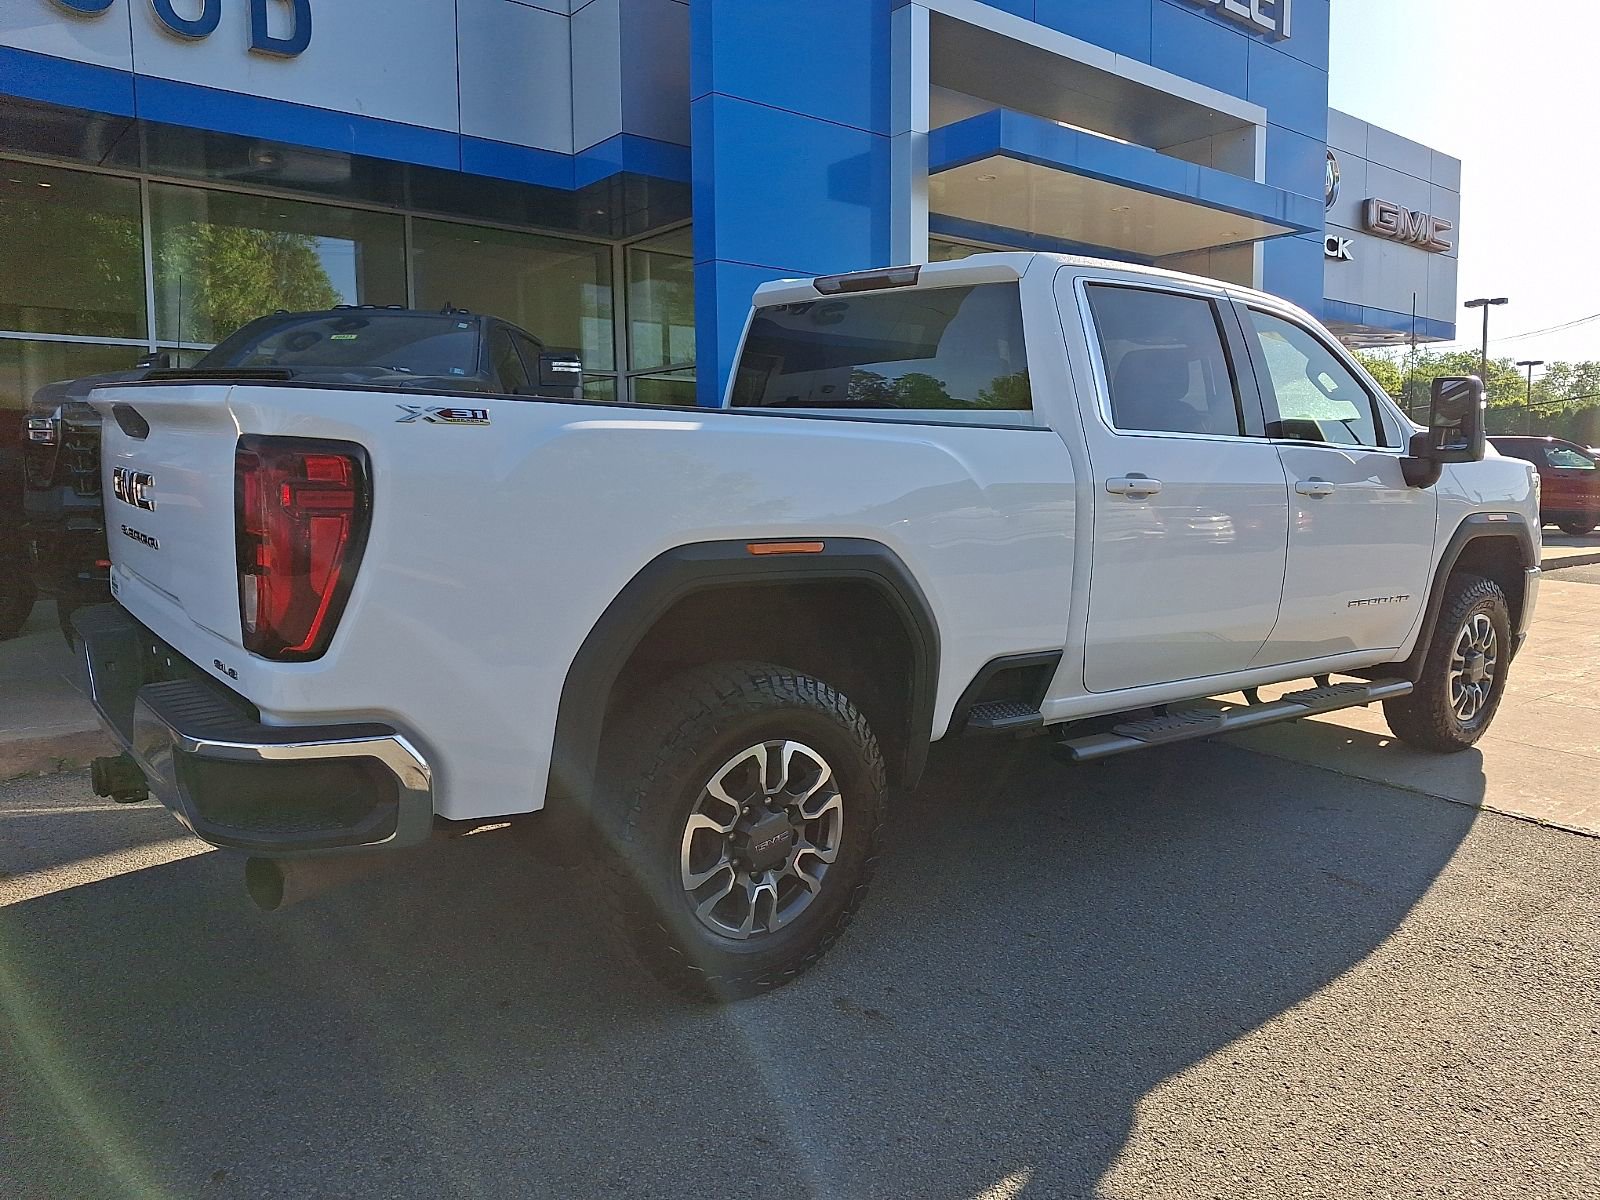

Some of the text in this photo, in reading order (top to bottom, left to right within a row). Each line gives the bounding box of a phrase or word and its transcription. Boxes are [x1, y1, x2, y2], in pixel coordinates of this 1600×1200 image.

[1364, 198, 1453, 252] GMC
[394, 404, 491, 425] X31
[113, 466, 156, 512] GMC
[754, 830, 790, 852] GMC
